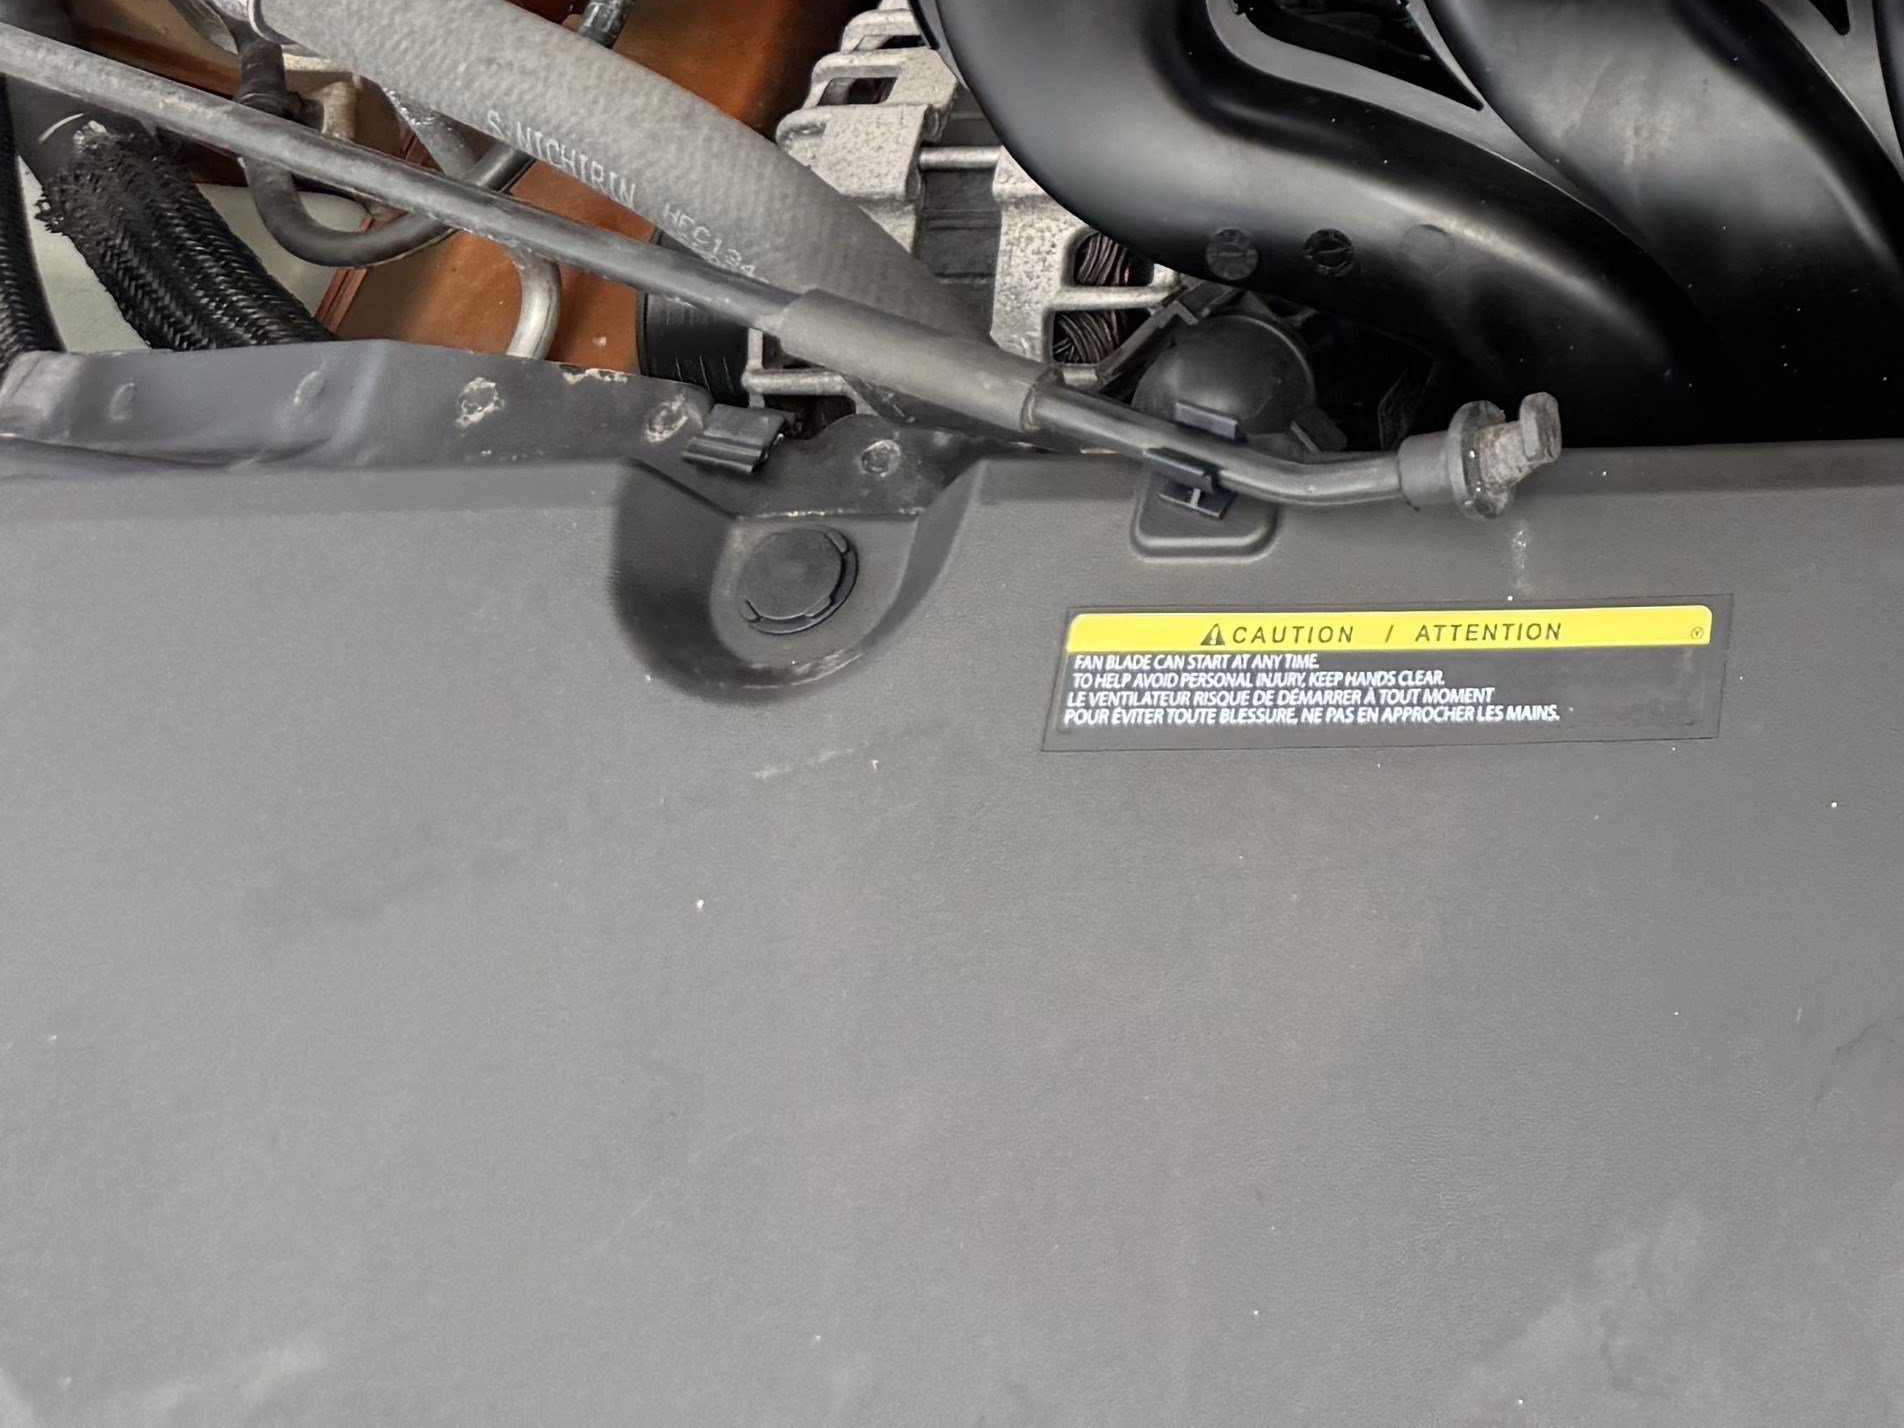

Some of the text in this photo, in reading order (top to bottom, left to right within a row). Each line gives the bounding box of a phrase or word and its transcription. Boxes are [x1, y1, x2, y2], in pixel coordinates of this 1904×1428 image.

[1232, 624, 1353, 643] CAUTION
[1415, 622, 1561, 642] ATTENTION
[1074, 653, 1319, 670] FAN BLADE CAN START AT ANY TIME.
[1074, 672, 1093, 688] TO
[1094, 672, 1131, 688] HELP
[1132, 672, 1178, 688] AVOID
[1180, 672, 1253, 687] PERSONAL
[1309, 671, 1348, 687] KEEP
[1348, 671, 1396, 687] HANDS
[1398, 670, 1445, 686] CLEAR.
[1066, 687, 1495, 706] LE VENTILATEUR RISQUE DE DÉMARRER À TOUT MOMENT
[1063, 704, 1560, 725] POUR ÉVITER TOUTE BLESSURE, NE PAS EN APPROCHER LES MAINS.
